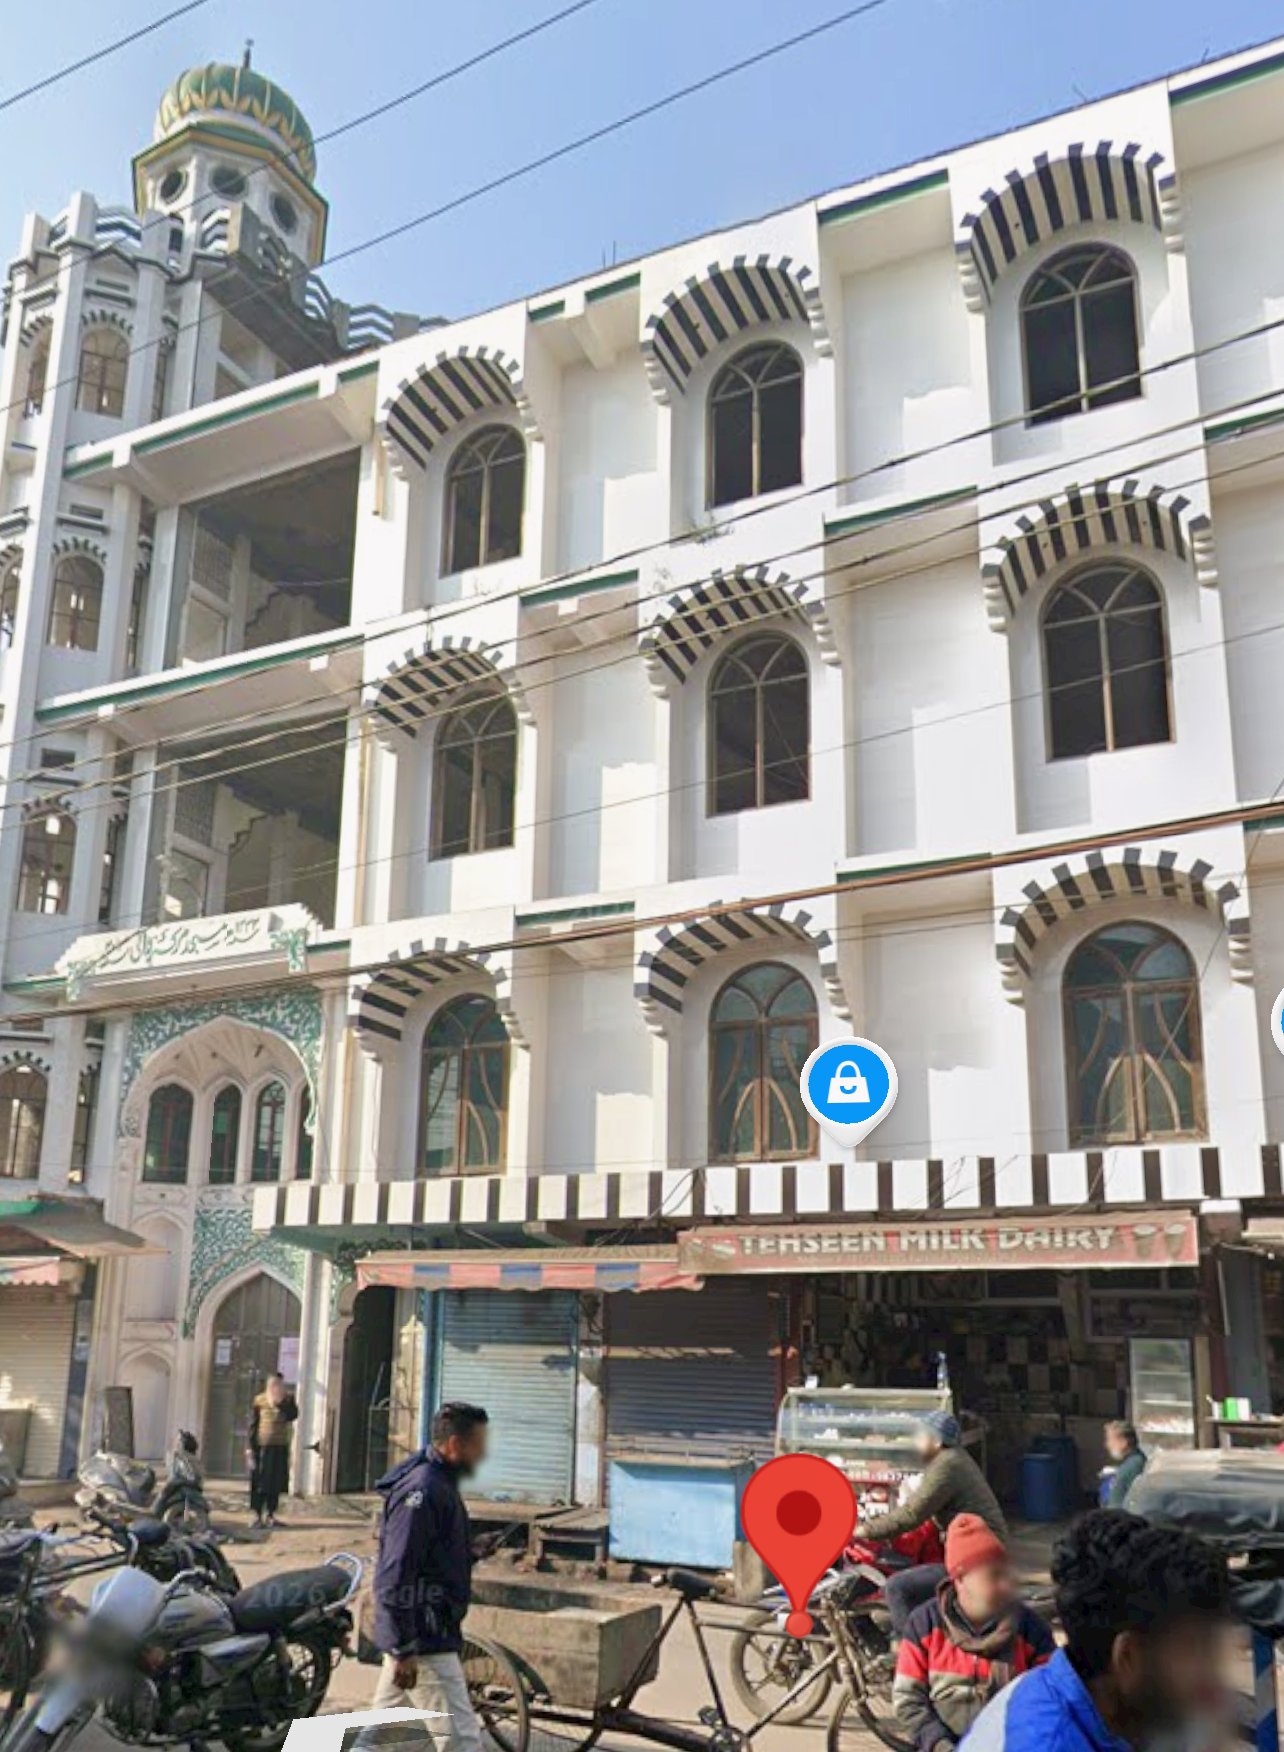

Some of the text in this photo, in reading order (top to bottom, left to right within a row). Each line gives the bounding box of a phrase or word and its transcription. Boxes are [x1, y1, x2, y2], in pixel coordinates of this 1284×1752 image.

[739, 1231, 887, 1256] TEHSEEN
[900, 1227, 986, 1251] MILK
[999, 1227, 1115, 1250] DAIRY
